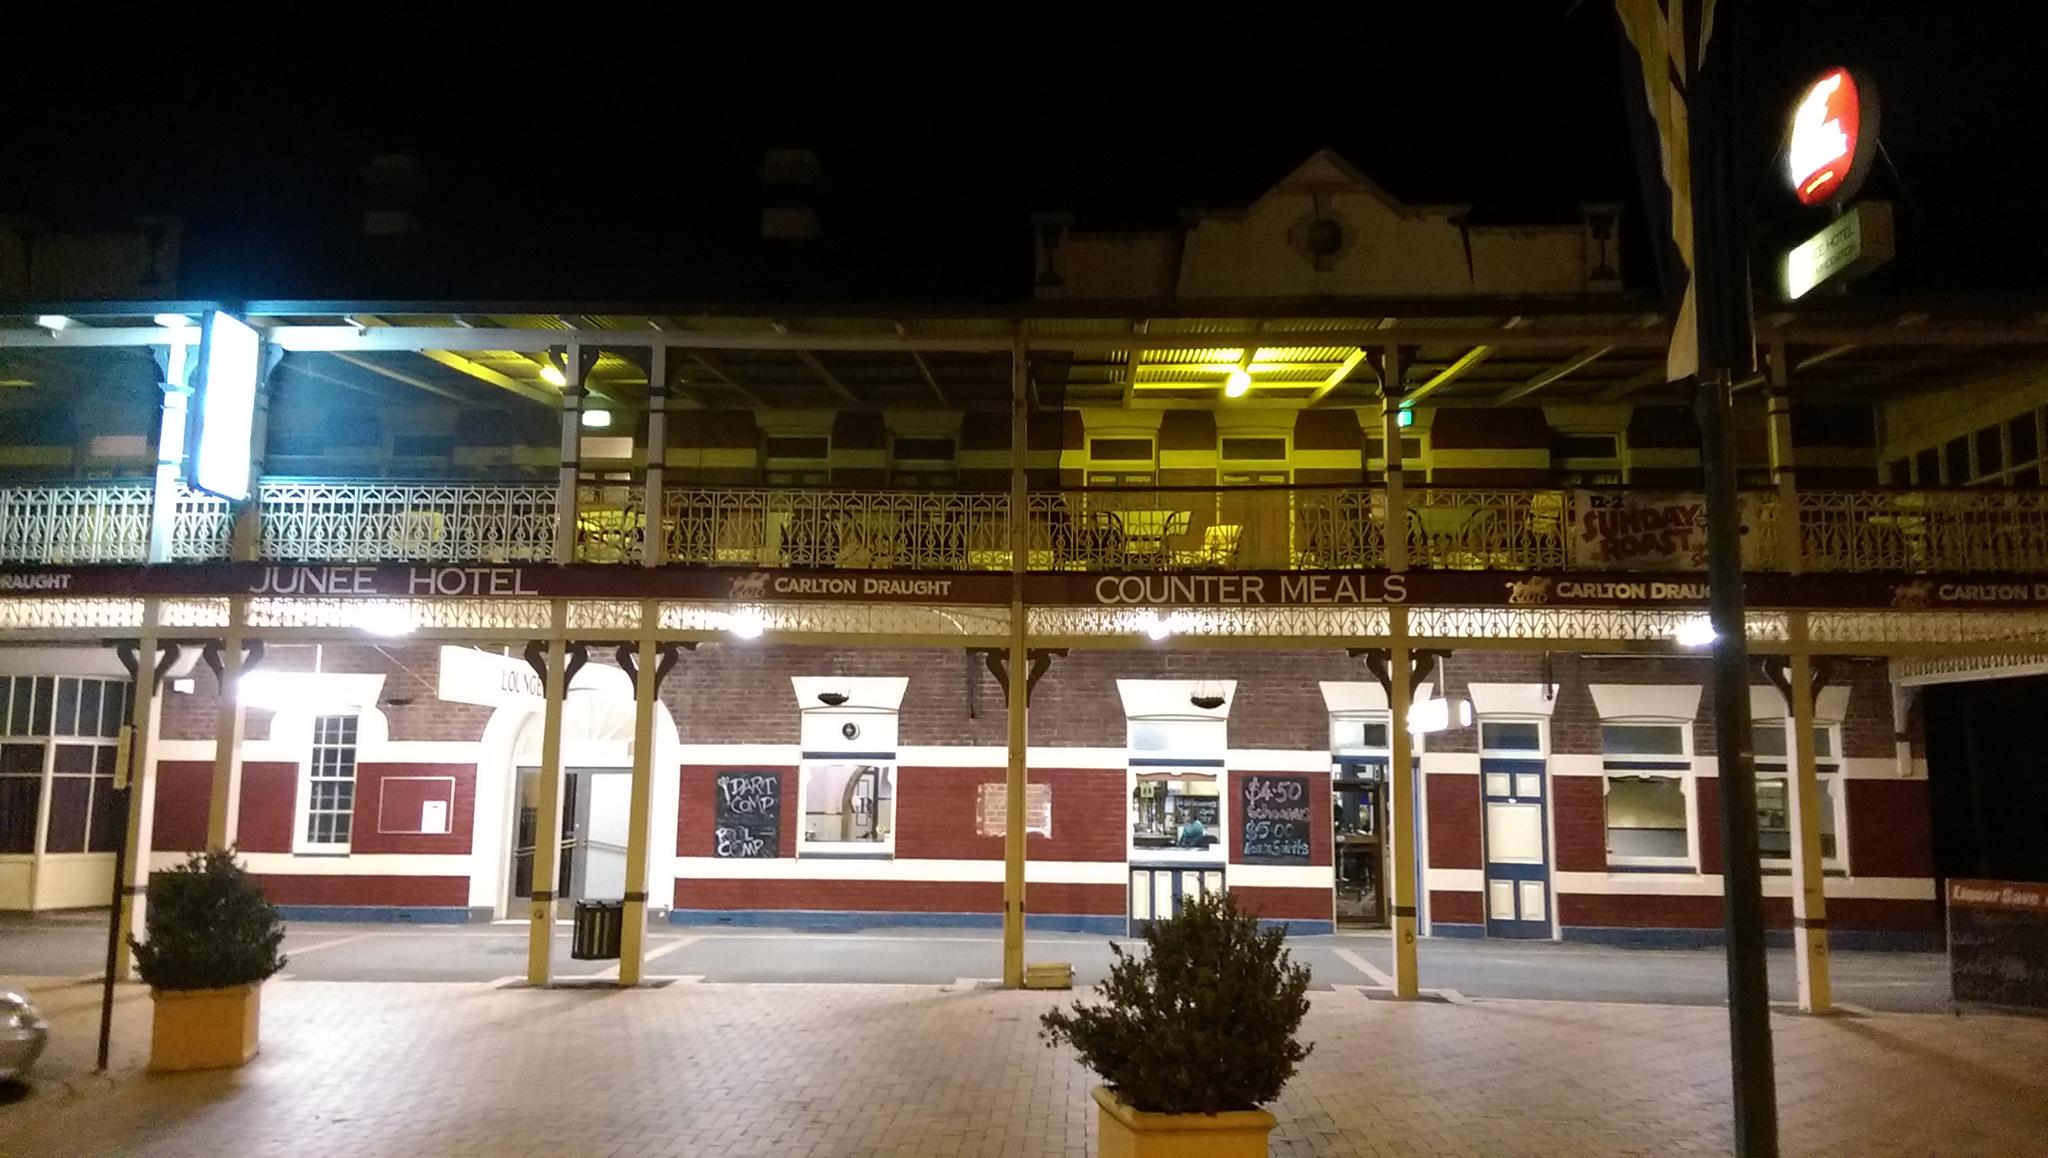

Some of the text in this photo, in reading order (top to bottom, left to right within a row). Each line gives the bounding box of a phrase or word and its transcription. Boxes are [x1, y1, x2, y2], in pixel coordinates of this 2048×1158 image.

[1582, 504, 1702, 543] SUNDAY
[1598, 528, 1693, 561] ROAST
[250, 566, 539, 595] JUNEE HOTEL
[774, 576, 951, 596] CARLTON DRAUGHT
[1095, 575, 1408, 604] COUNTER MEALS
[1556, 582, 1712, 600] CARLTON DRAU
[1938, 583, 2028, 600] CARLTON
[729, 776, 777, 796] DART
[731, 795, 775, 814] COMP
[716, 826, 753, 843] POOL
[718, 839, 764, 857] COMP
